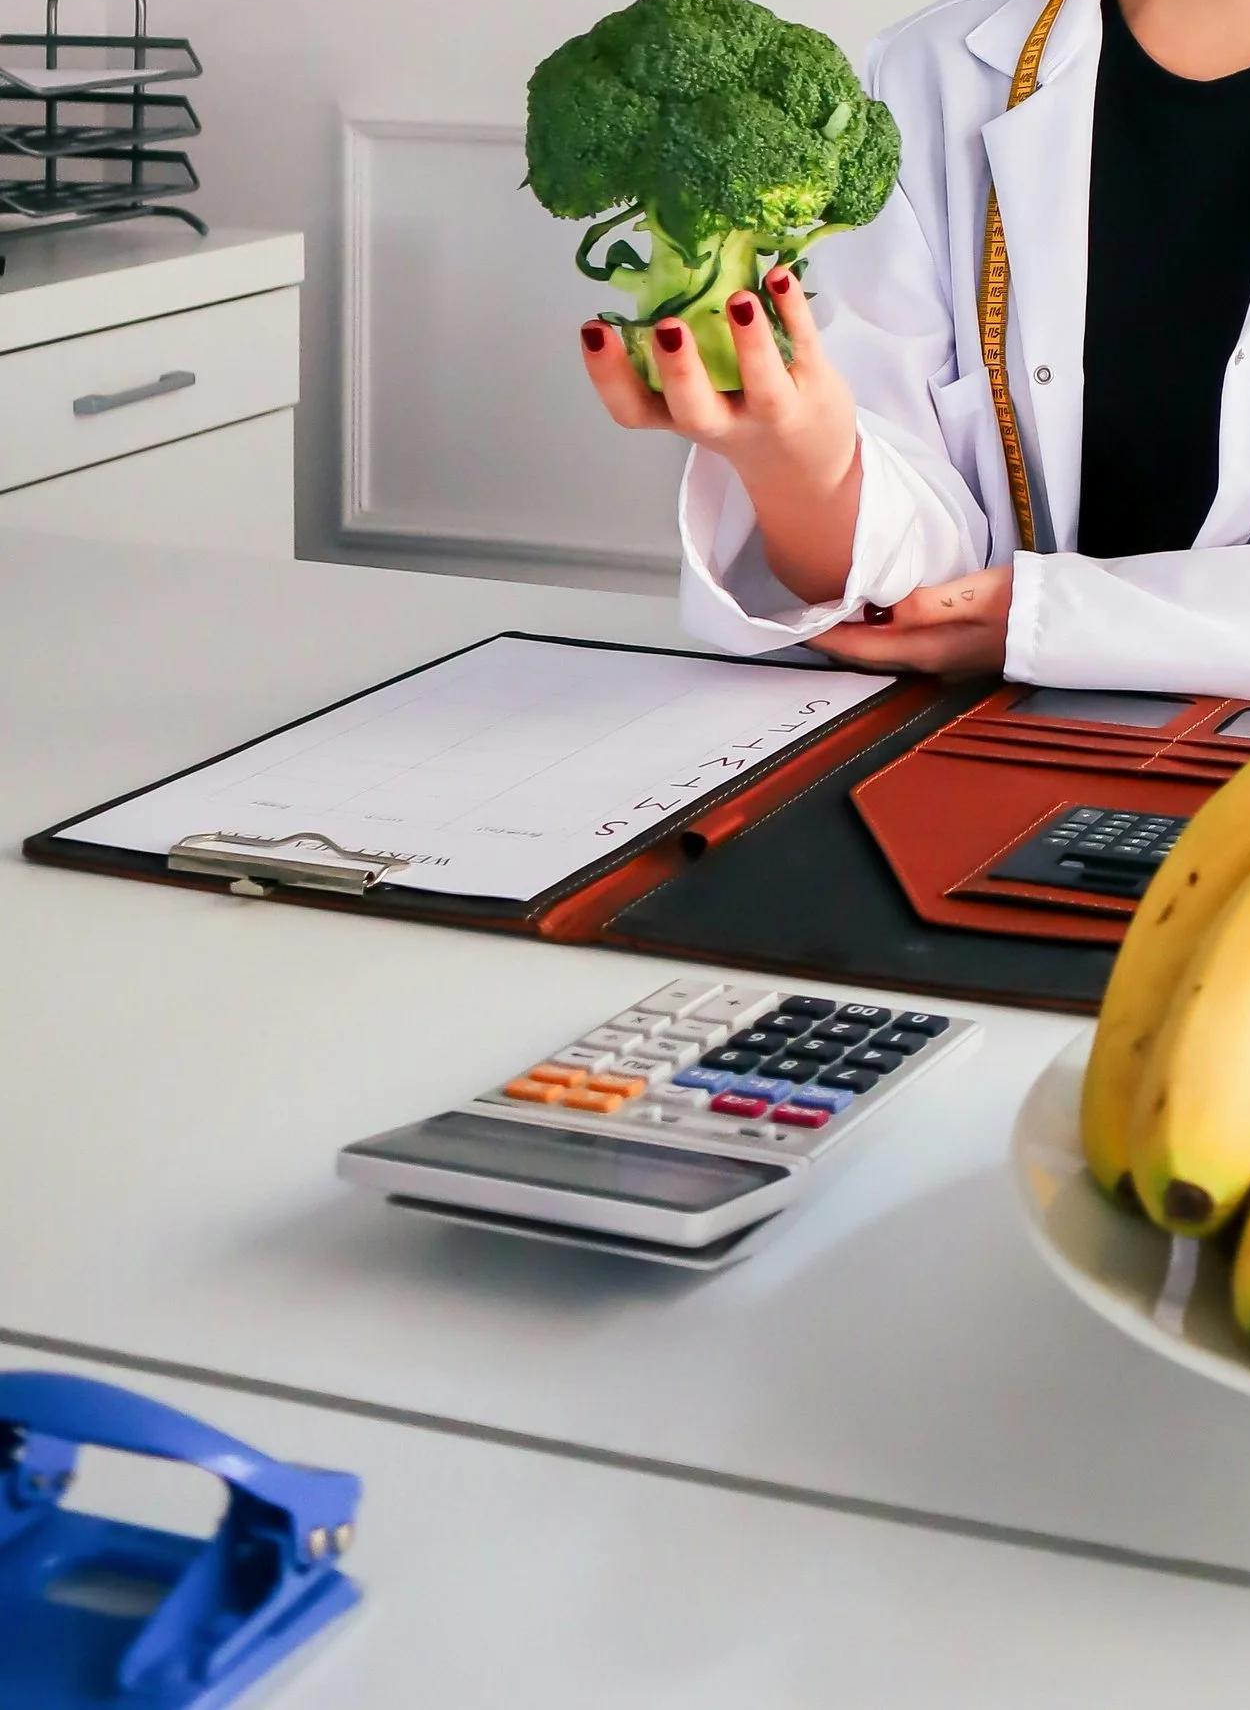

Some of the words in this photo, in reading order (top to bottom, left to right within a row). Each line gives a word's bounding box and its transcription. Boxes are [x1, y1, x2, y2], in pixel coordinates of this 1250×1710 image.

[994, 246, 1004, 257] 111
[992, 266, 1004, 277] 112
[990, 286, 1002, 298] 113
[988, 306, 1001, 317] 114
[987, 327, 1000, 338] 115
[986, 348, 999, 360] 116
[799, 700, 831, 714] S
[768, 721, 807, 732] F
[732, 738, 763, 749] T
[698, 757, 745, 770] W
[670, 776, 701, 788] T
[634, 797, 681, 811] M
[595, 821, 628, 836] S
[847, 1005, 879, 1017] 00
[773, 1016, 793, 1025] 3
[911, 1014, 929, 1023] 0
[831, 1024, 849, 1033] 2
[750, 1033, 766, 1042] 6
[890, 1033, 902, 1042] 1
[804, 1040, 824, 1049] 5
[720, 1051, 739, 1061] 9
[864, 1051, 882, 1060] 4
[778, 1060, 798, 1070] 8
[836, 1070, 856, 1079] 7
